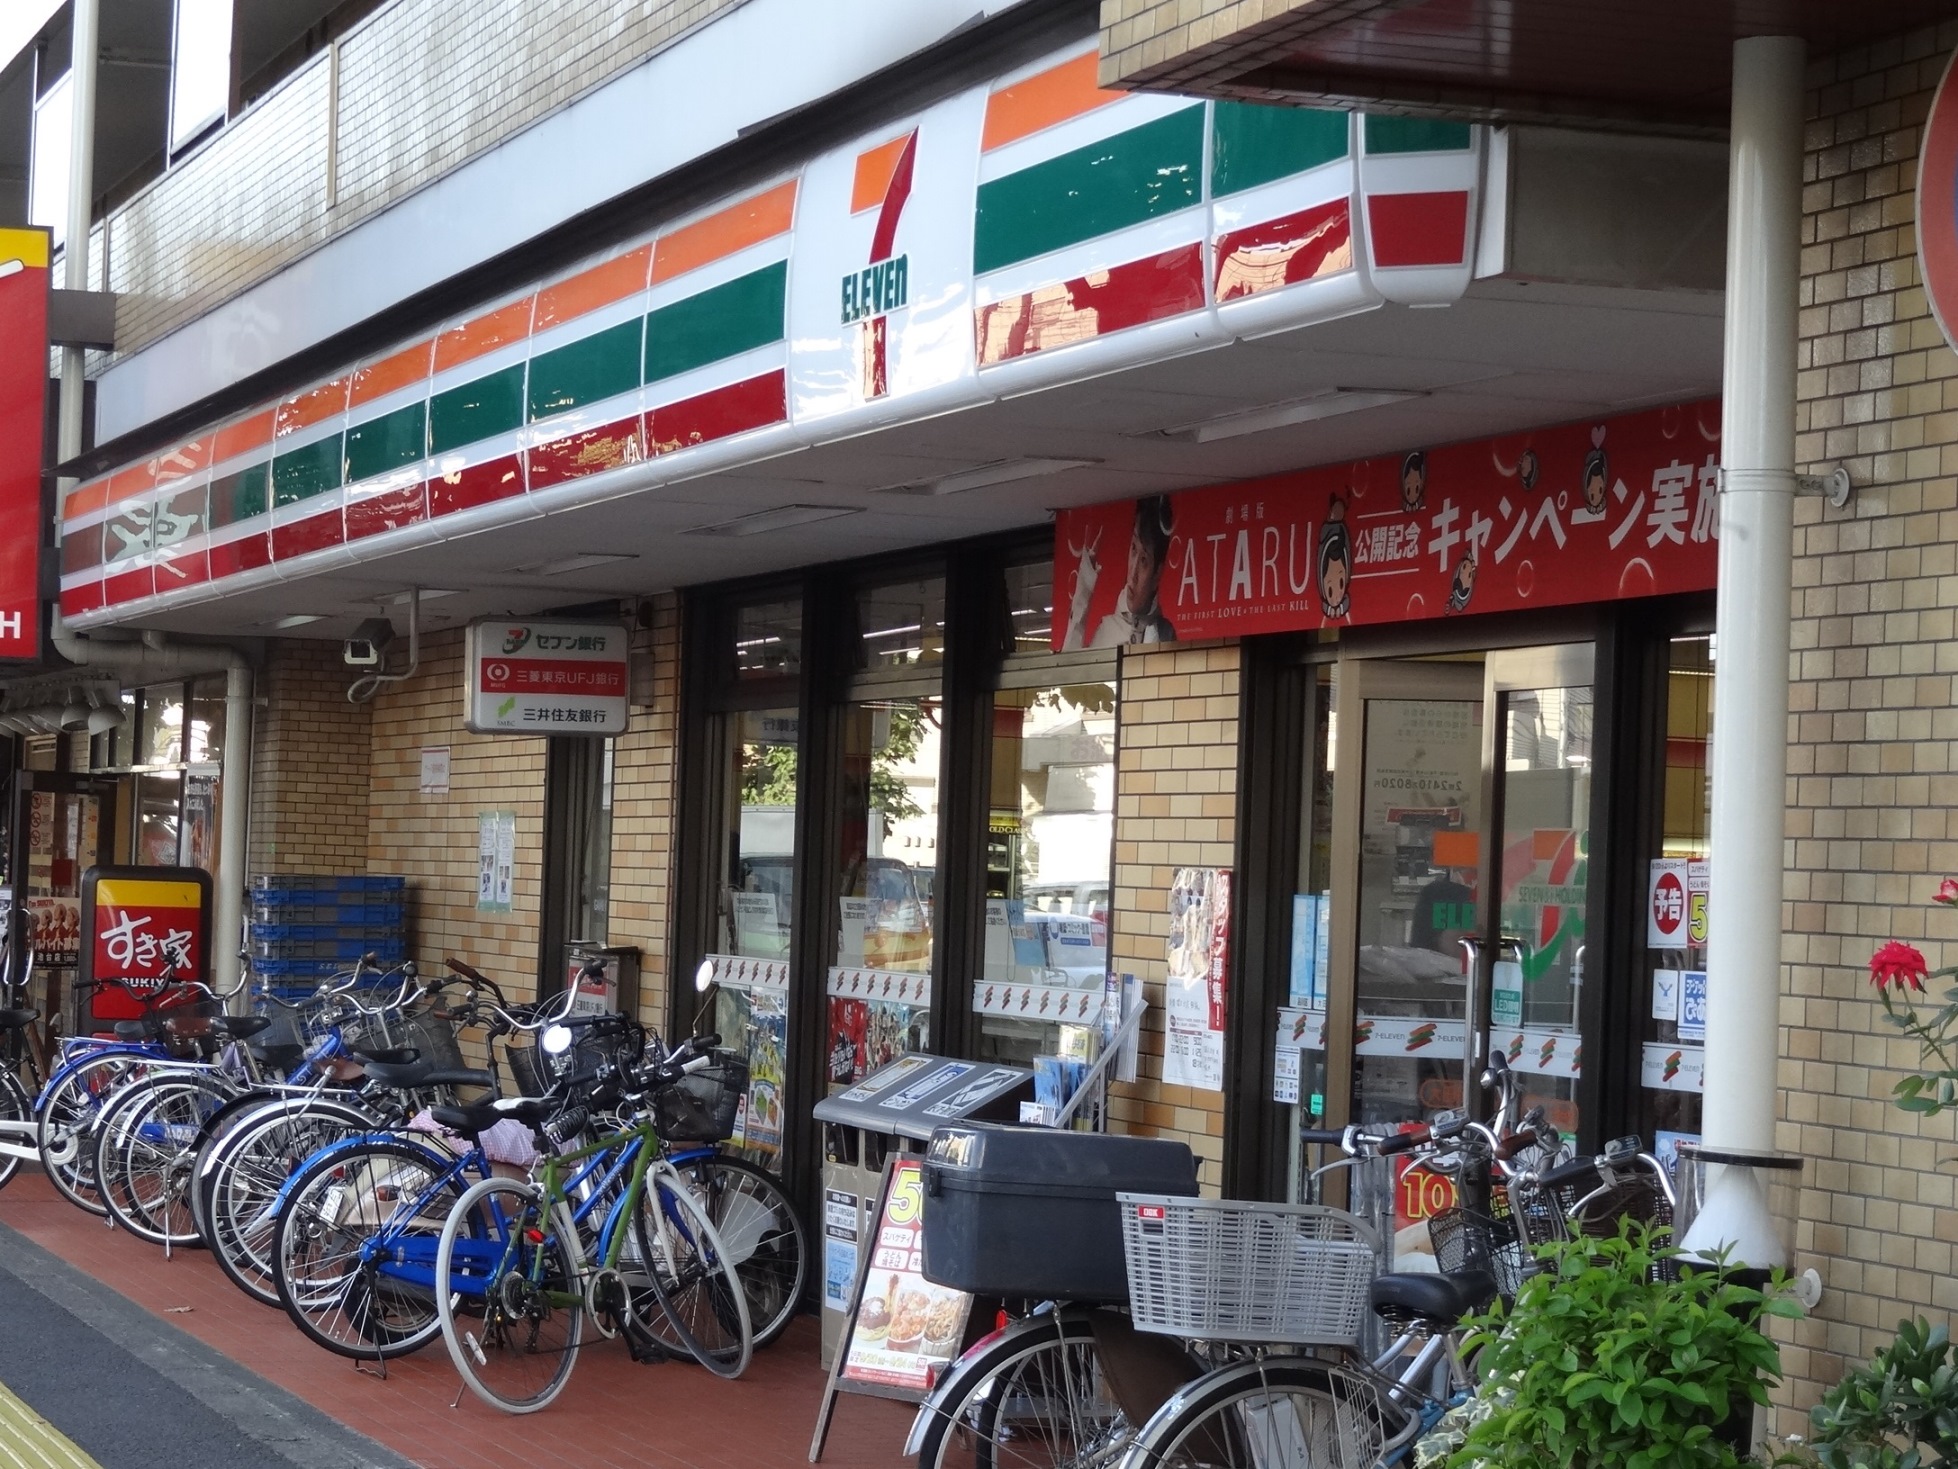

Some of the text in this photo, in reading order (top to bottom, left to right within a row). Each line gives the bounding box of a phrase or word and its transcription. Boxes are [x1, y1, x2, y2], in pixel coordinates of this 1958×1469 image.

[1354, 521, 1422, 564] 公開記念
[1177, 521, 1313, 607] ATARU
[1218, 605, 1242, 619] LOVE
[1289, 600, 1310, 612] KILL
[516, 670, 619, 686] 三菱東京UFJ銀行
[523, 707, 607, 723] 三井住友銀行
[1654, 888, 1682, 921] 予告
[100, 909, 193, 970] すき家
[1403, 1172, 1459, 1218] 10
